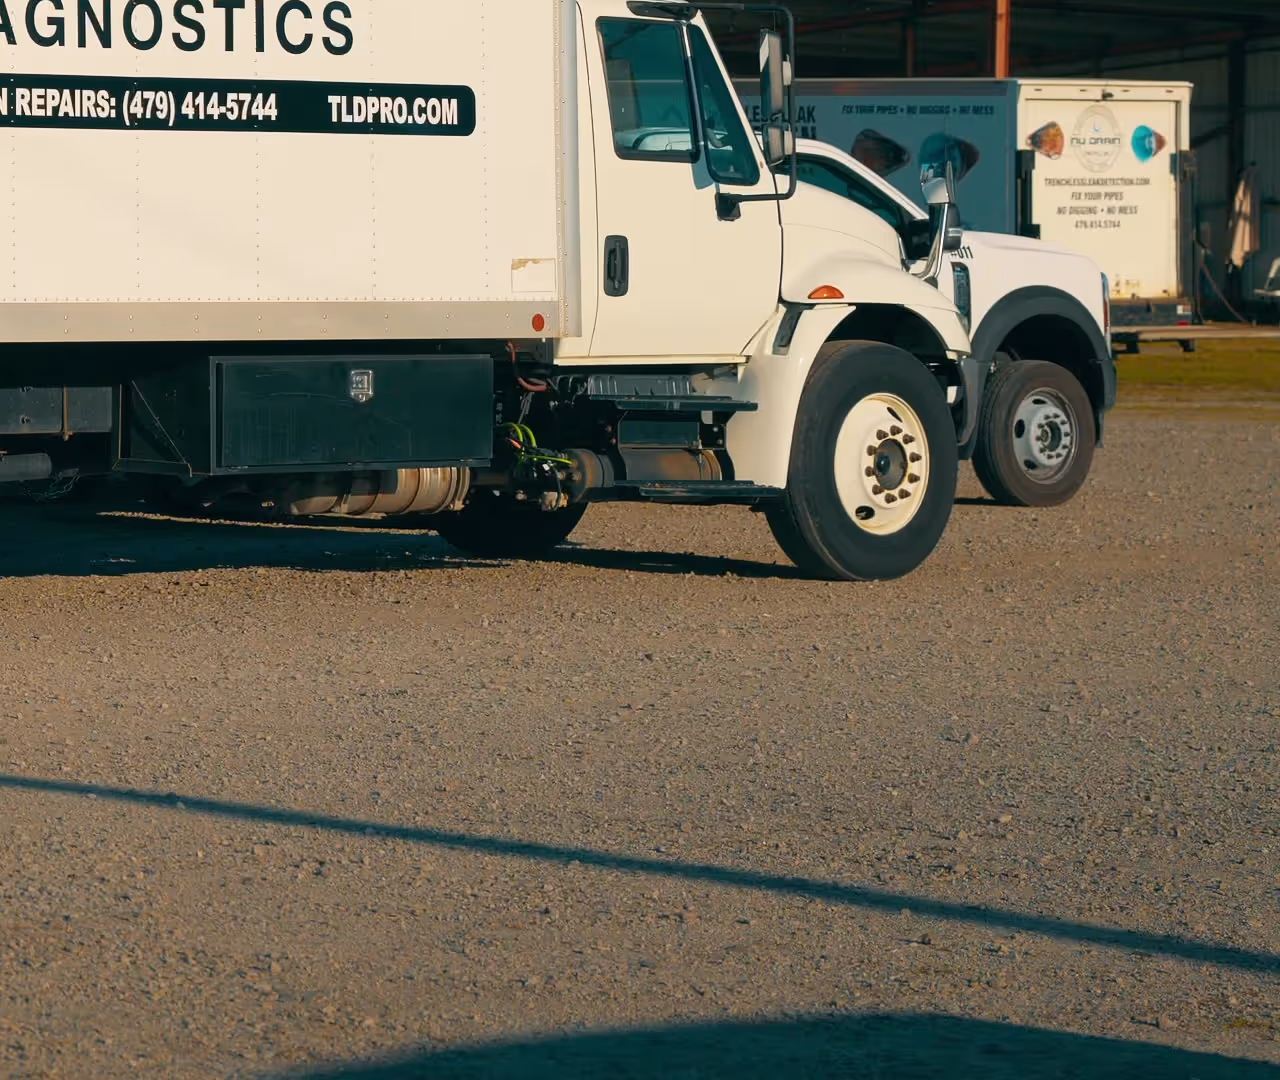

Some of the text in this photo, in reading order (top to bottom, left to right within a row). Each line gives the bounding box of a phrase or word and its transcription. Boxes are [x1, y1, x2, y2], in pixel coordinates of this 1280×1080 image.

[15, 87, 117, 119] REPAIRS:
[122, 89, 176, 127] (479)
[180, 91, 279, 121] 414-5744
[327, 94, 458, 126] TLDPRO.COM
[1071, 192, 1081, 201] FIX
[1104, 192, 1124, 201] PIPES
